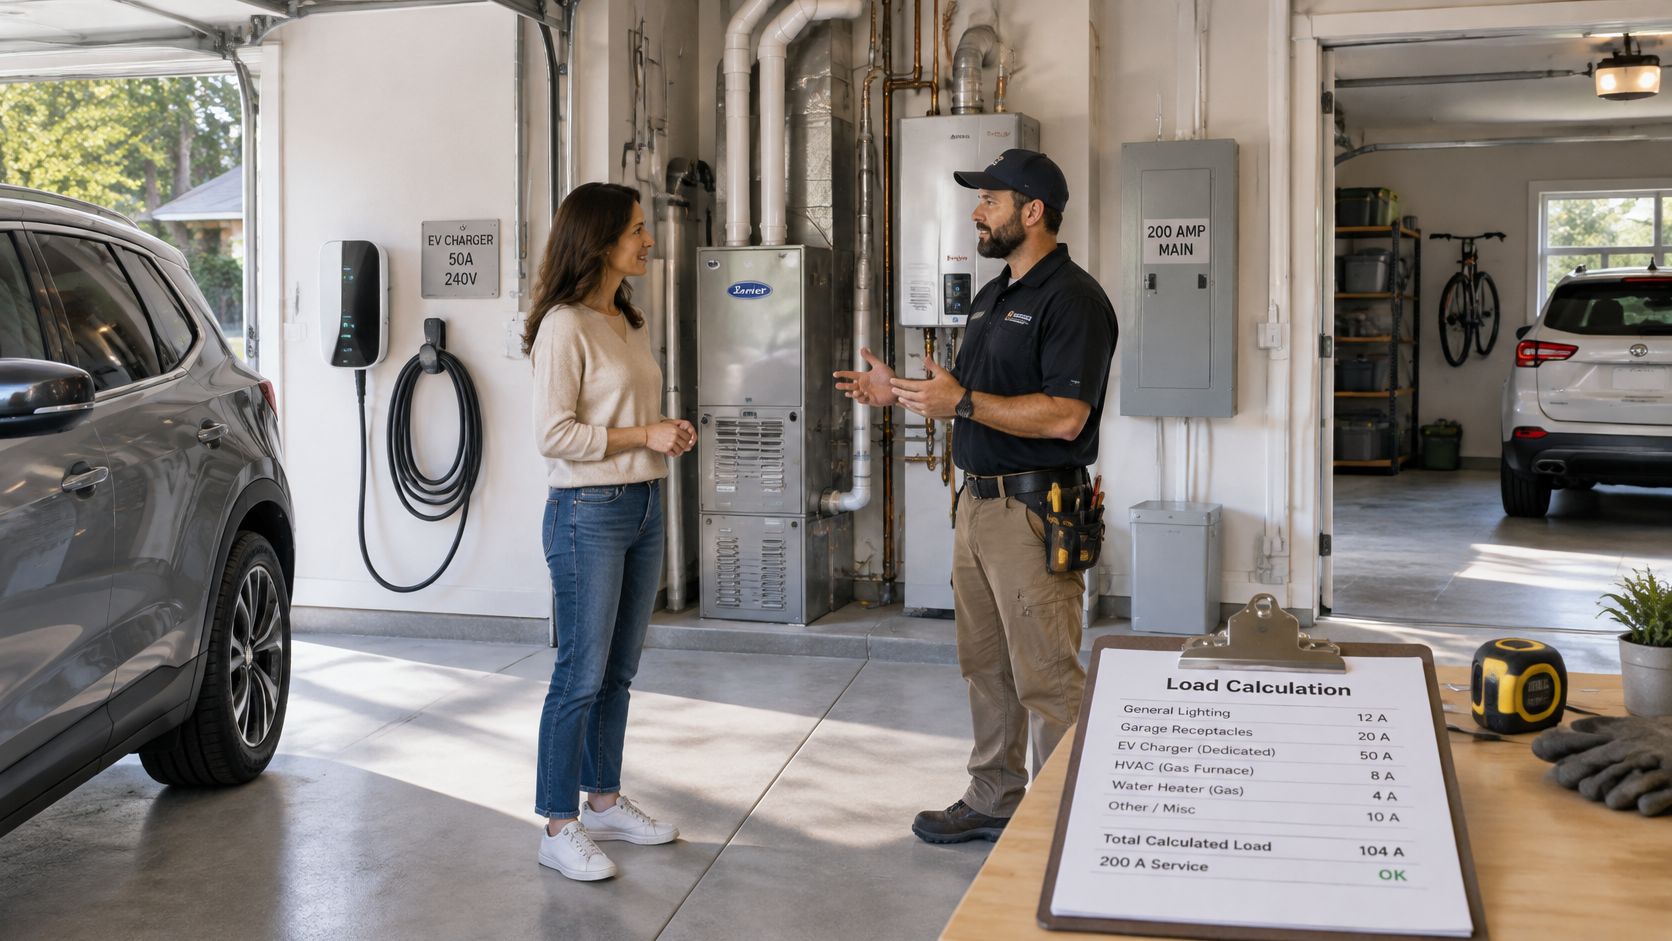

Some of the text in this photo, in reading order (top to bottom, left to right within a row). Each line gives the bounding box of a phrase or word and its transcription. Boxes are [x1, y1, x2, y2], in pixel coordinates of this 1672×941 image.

[1147, 225, 1206, 238] 200 AMP
[428, 234, 493, 246] EV CHARGER
[1159, 243, 1193, 256] MAIN
[449, 252, 474, 266] 50A
[445, 273, 477, 286] 240V
[1166, 677, 1352, 696] Load Calculation
[1123, 705, 1231, 719] General Lighting
[1357, 713, 1388, 723] 12 A
[1120, 722, 1253, 738] Garage Receptacles
[1357, 732, 1391, 742] 20 A
[1117, 741, 1276, 758] EV Charger (Dedicated)
[1360, 751, 1393, 761] 50 A
[1114, 761, 1255, 777] HVAC (Gas Furnace)
[1370, 770, 1395, 781] 8 A
[1112, 780, 1245, 797] Water Heater (Gas)
[1372, 791, 1398, 802] 4 A
[1108, 801, 1196, 815] Other / Misc
[1366, 811, 1400, 823] 10 A
[1103, 833, 1272, 852] Total Calculated Load
[1359, 845, 1405, 857] 104 A
[1099, 856, 1209, 872] 200 A Service
[1378, 869, 1407, 881] OK
